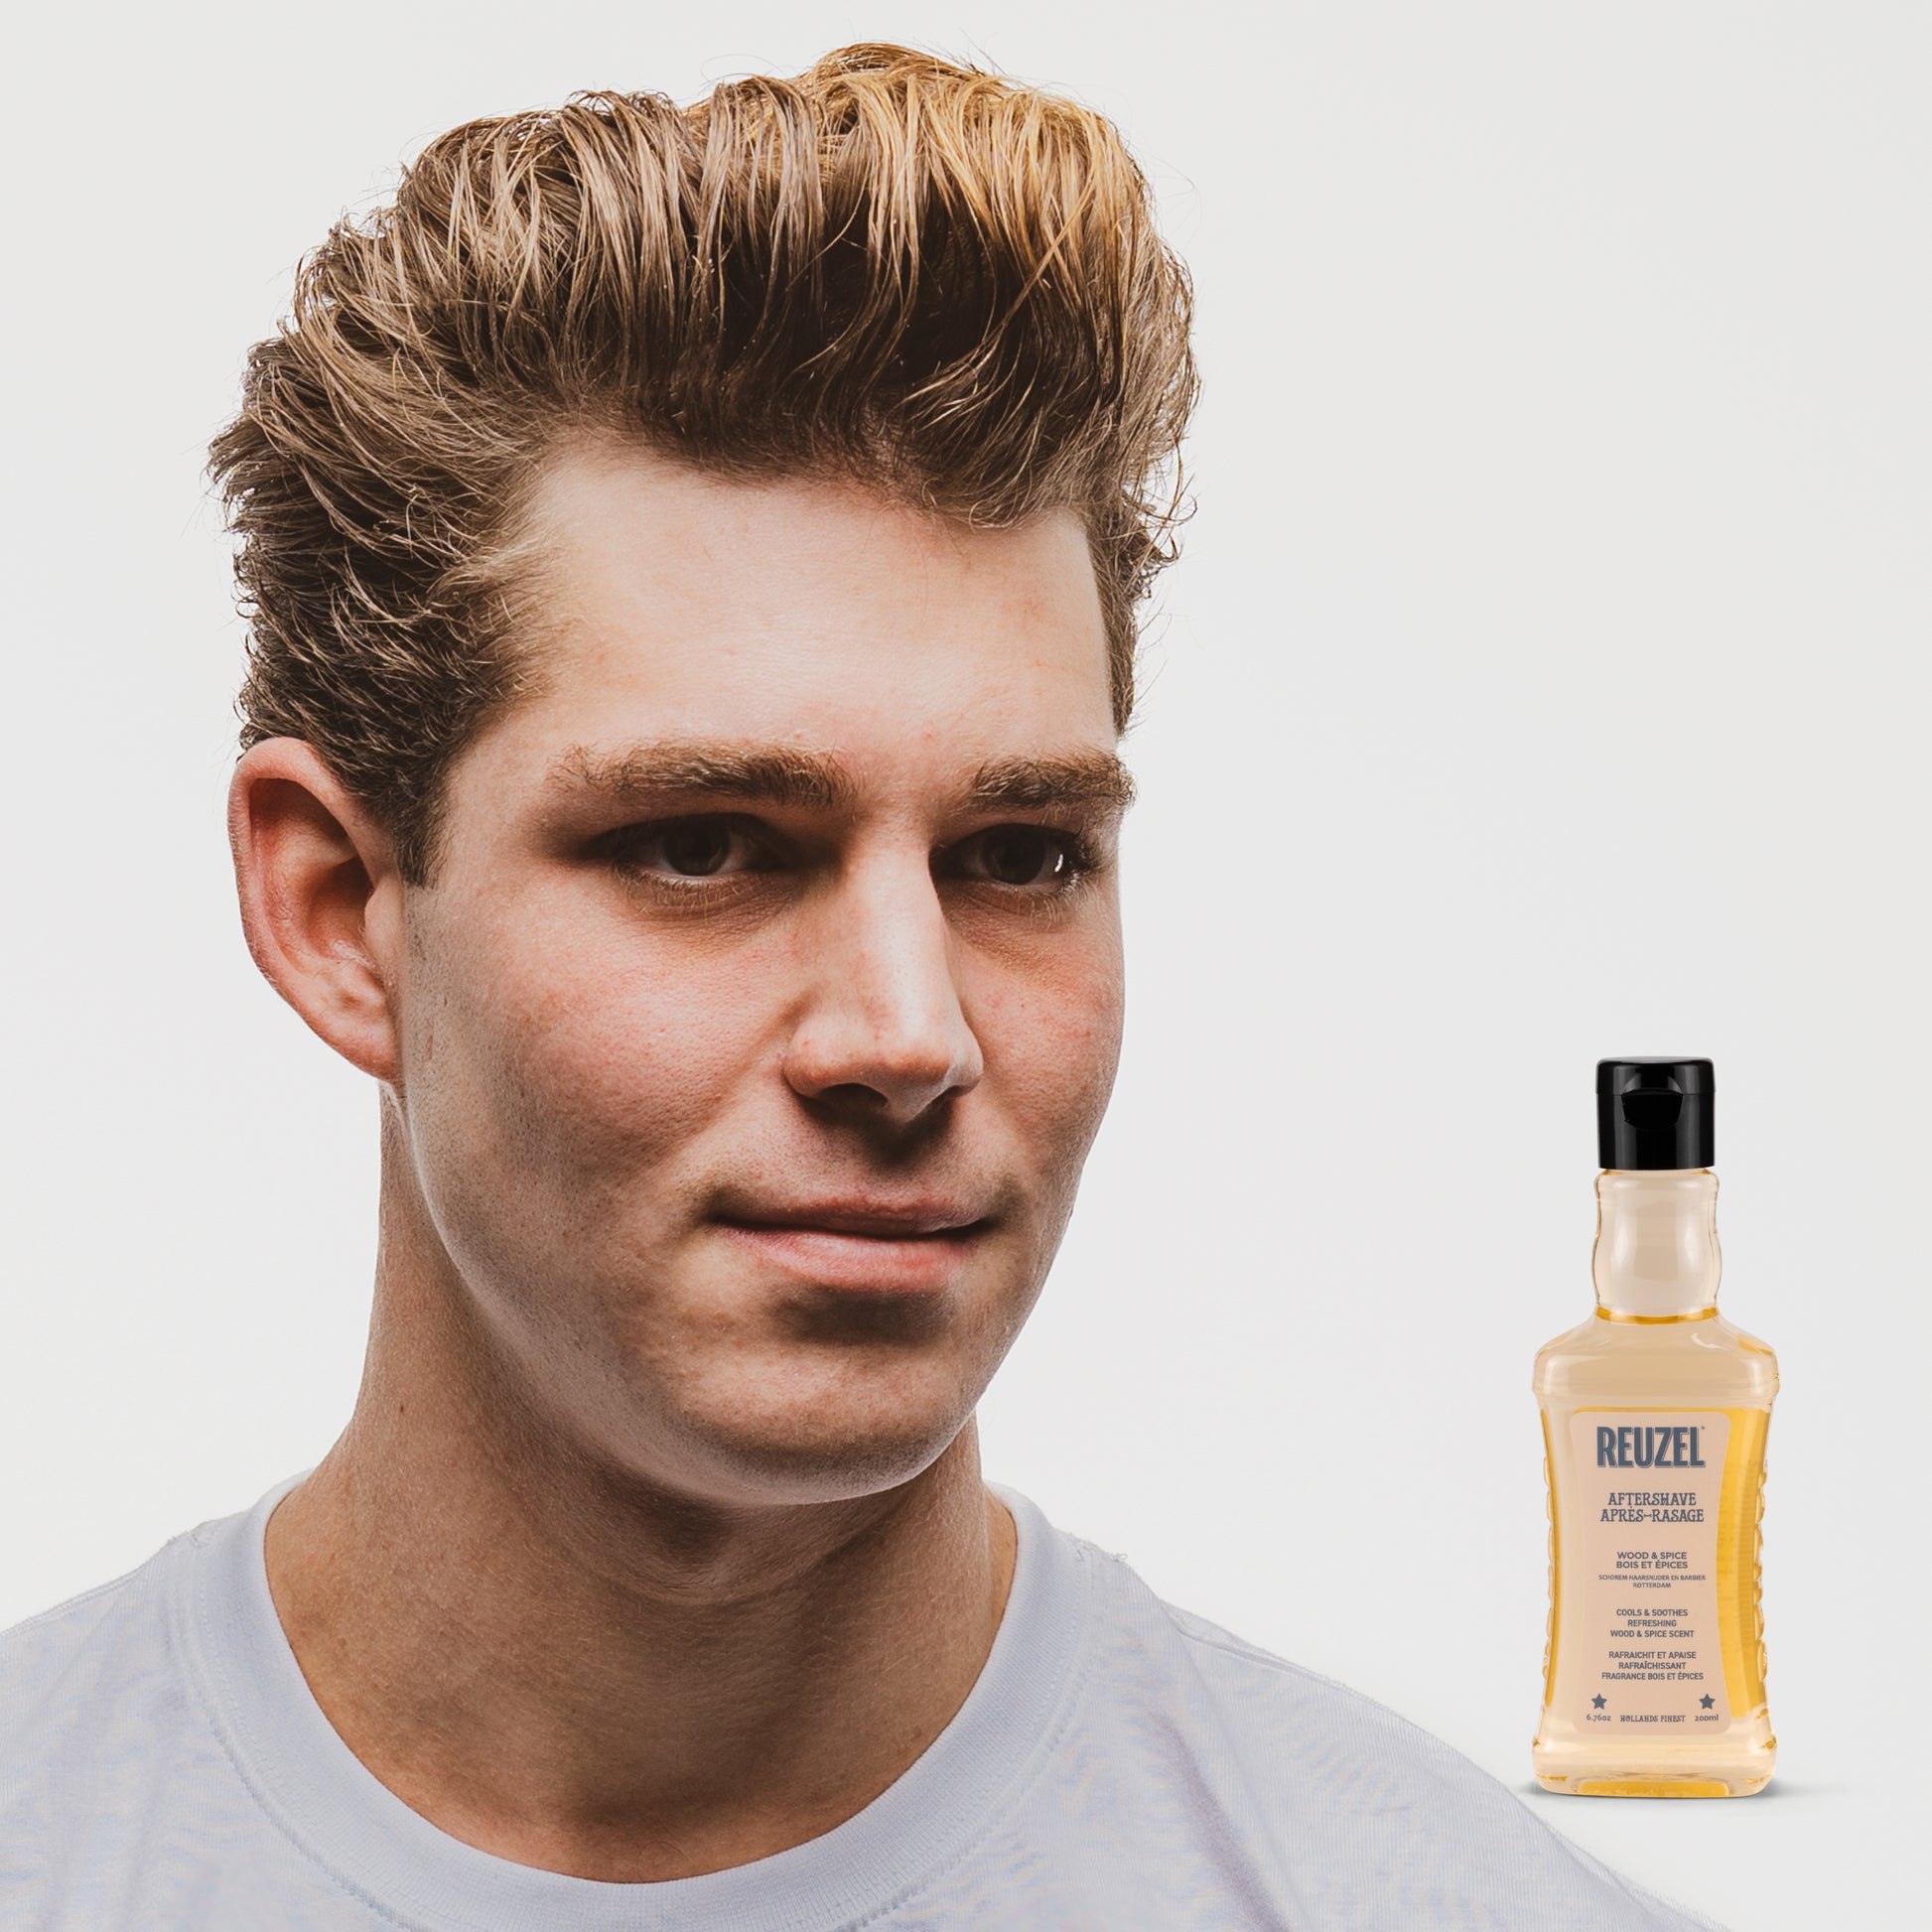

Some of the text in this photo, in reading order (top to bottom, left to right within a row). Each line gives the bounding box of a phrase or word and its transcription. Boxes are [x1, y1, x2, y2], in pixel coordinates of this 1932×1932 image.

[1596, 1427, 1706, 1468] REUZEL
[1607, 1492, 1697, 1506] AFTERSHAVE
[1599, 1506, 1705, 1523] APRÈS-RASAGE
[1616, 1560, 1689, 1570] BOIS ET ÉPICES
[1616, 1608, 1689, 1617] COOLS & SOOTHES
[1618, 1660, 1687, 1670] RAFRAÎCHISSANT
[1647, 1672, 1666, 1681] BOIS
[1678, 1671, 1705, 1681] ÉPICES
